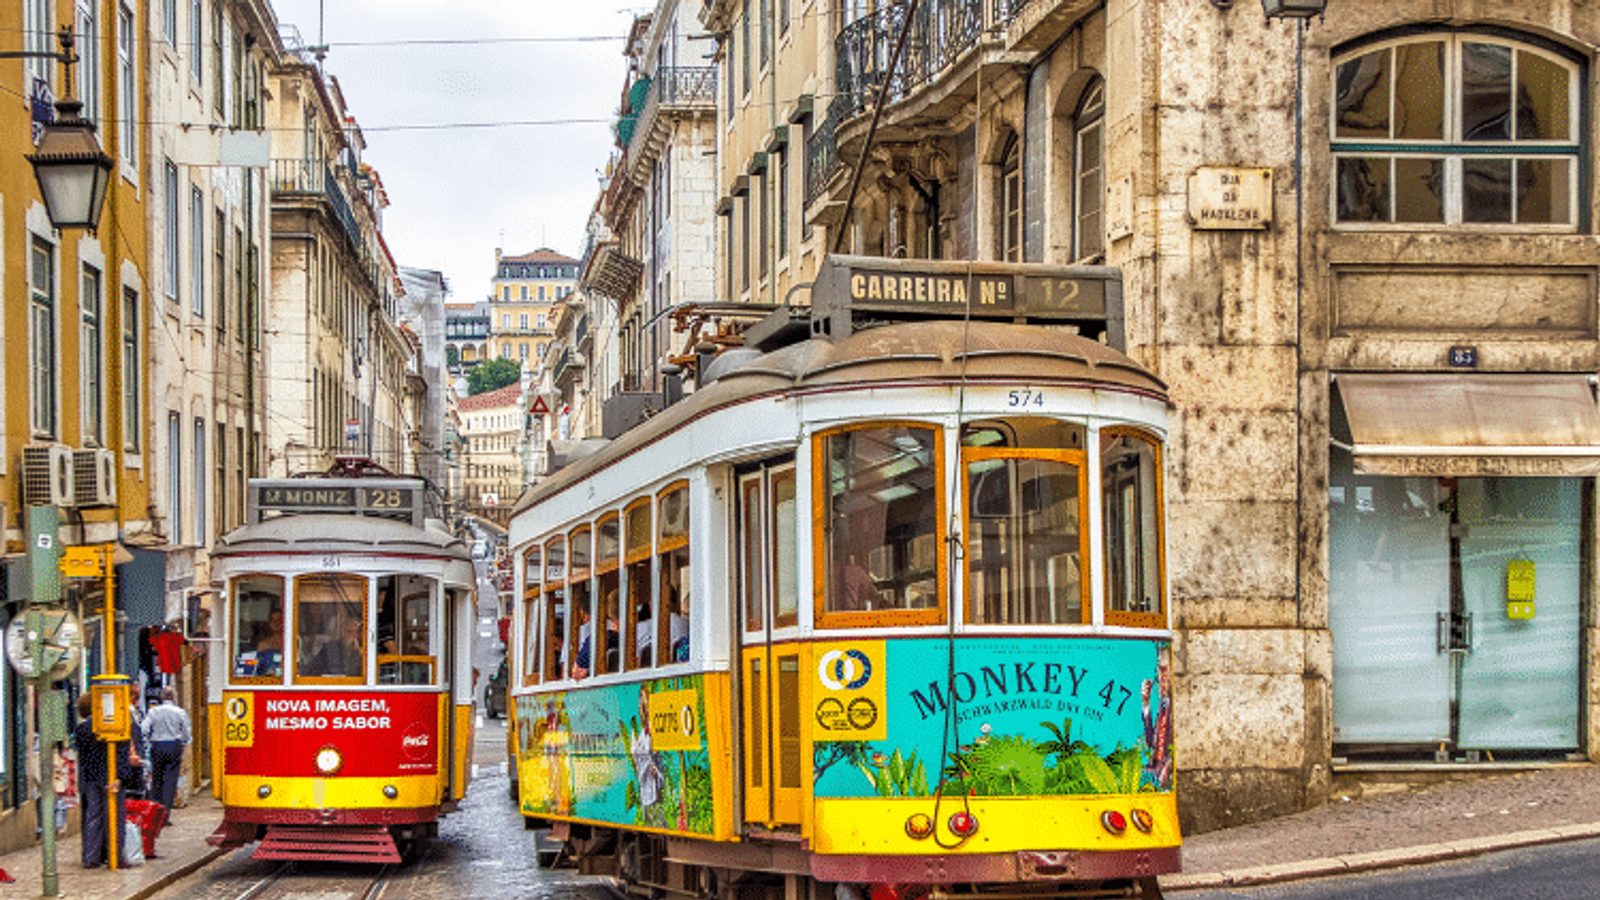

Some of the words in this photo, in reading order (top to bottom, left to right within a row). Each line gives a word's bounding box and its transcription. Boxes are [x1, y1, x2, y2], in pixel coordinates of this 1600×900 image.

[850, 273, 968, 303] CARREIRA
[1041, 279, 1080, 309] 12
[1008, 390, 1044, 407] 574
[286, 490, 348, 505] MONIZ
[371, 490, 402, 508] 28
[909, 661, 1089, 720] MONKEY
[1098, 679, 1133, 716] 47
[265, 699, 311, 713] NOVA
[315, 699, 391, 714] IMAGEM,
[265, 716, 328, 730] MESMO
[331, 716, 392, 730] SABOR
